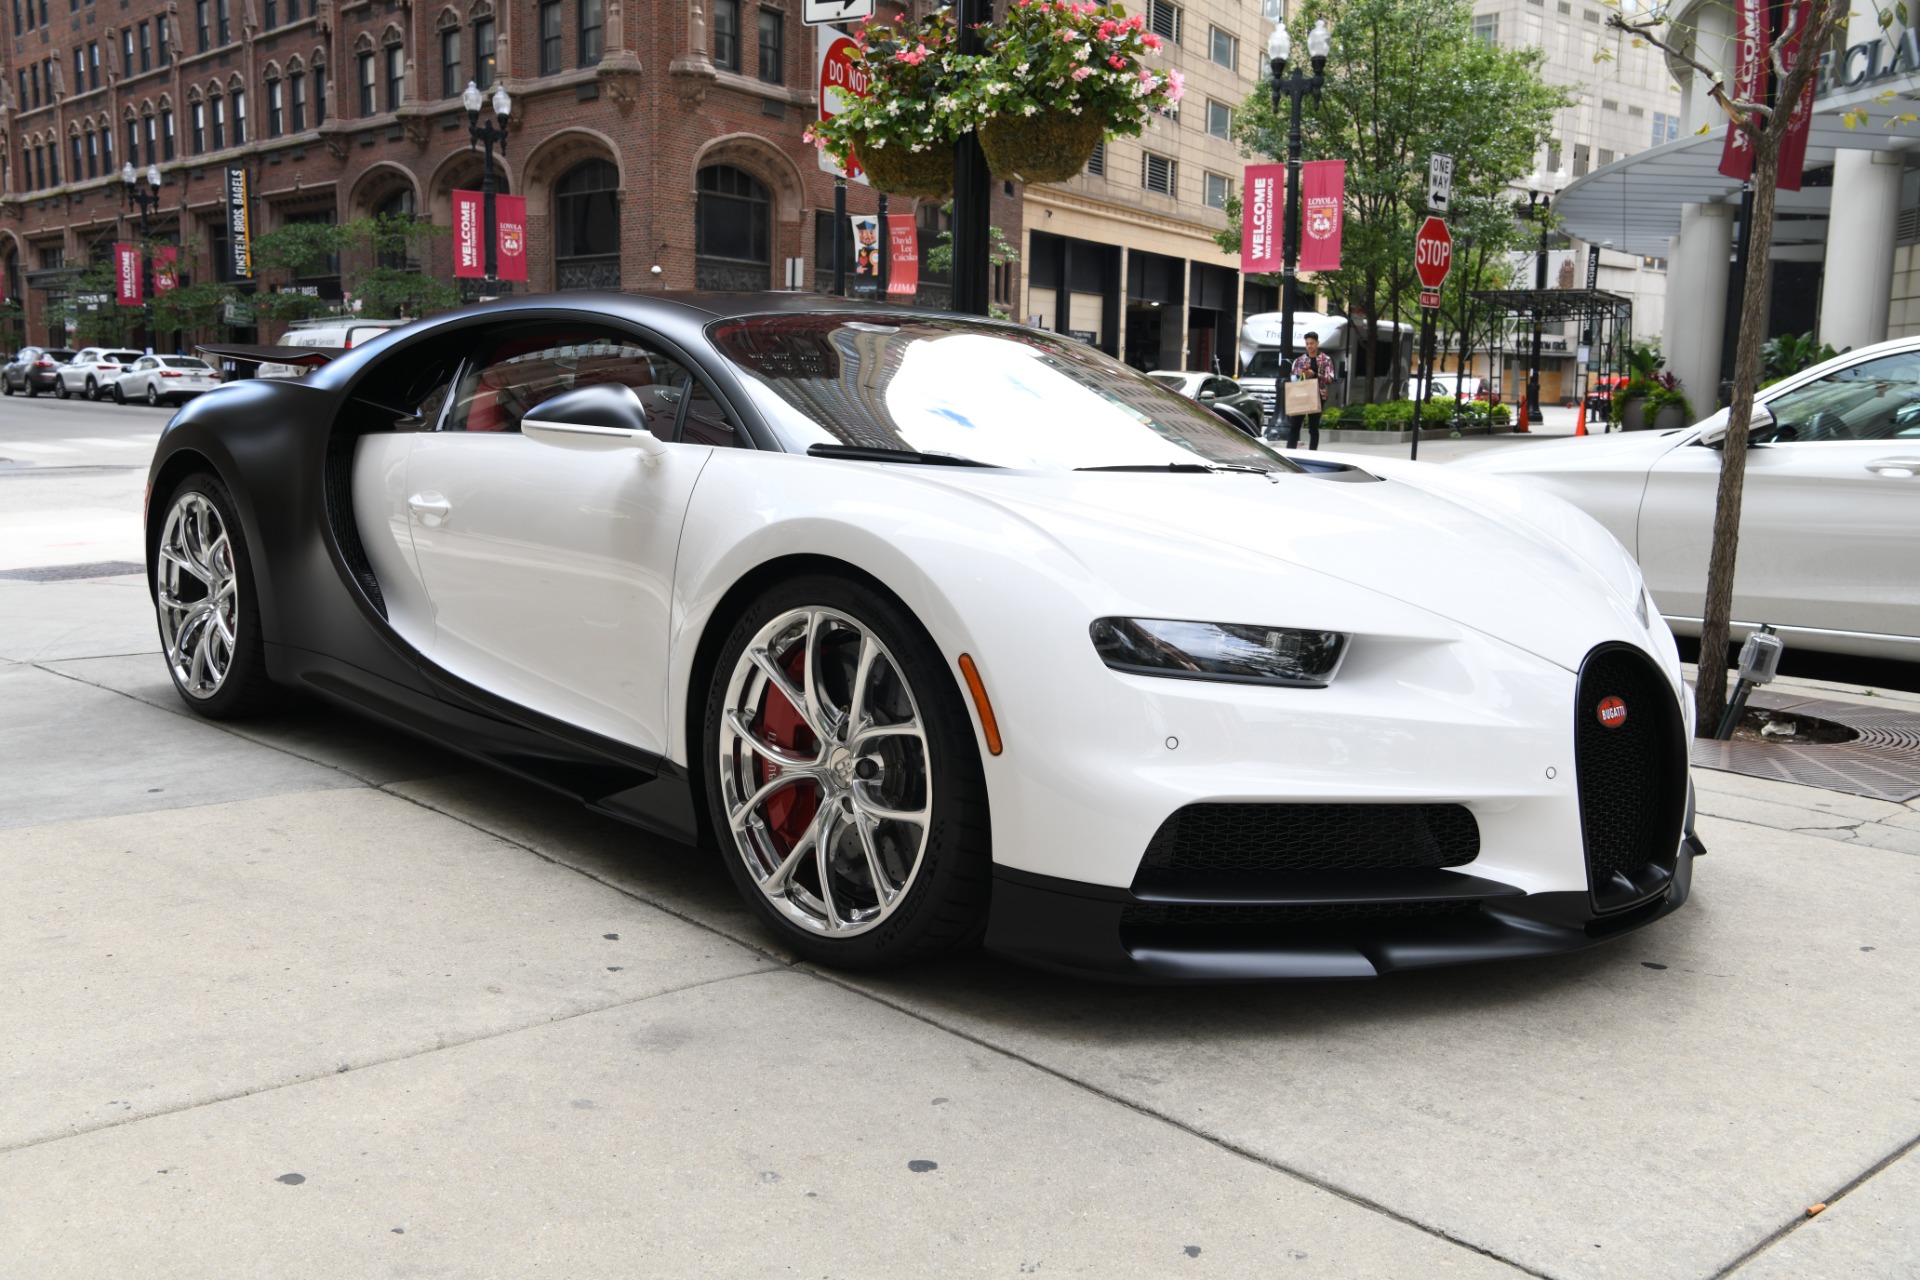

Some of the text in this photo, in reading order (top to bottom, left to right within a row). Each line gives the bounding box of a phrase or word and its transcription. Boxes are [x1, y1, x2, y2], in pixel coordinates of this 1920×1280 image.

[829, 59, 868, 95] DO NOT
[1732, 0, 1755, 148] WLCOME
[1433, 158, 1450, 174] ONE
[231, 169, 244, 205] BAGELS
[1432, 175, 1449, 189] WAY
[1308, 197, 1338, 205] LOYOLA
[500, 222, 522, 231] LOYOLA
[1251, 178, 1266, 259] WELCOME
[461, 201, 472, 267] WELCOME
[892, 236, 913, 245] David
[234, 234, 247, 275] EINSTEIN
[901, 244, 913, 253] Lee
[1418, 238, 1450, 267] STOP
[121, 251, 132, 298] WELCOME
[887, 282, 917, 294] LUMA
[1422, 295, 1439, 306] ALL WAY
[1601, 705, 1626, 720] BUGATTI
